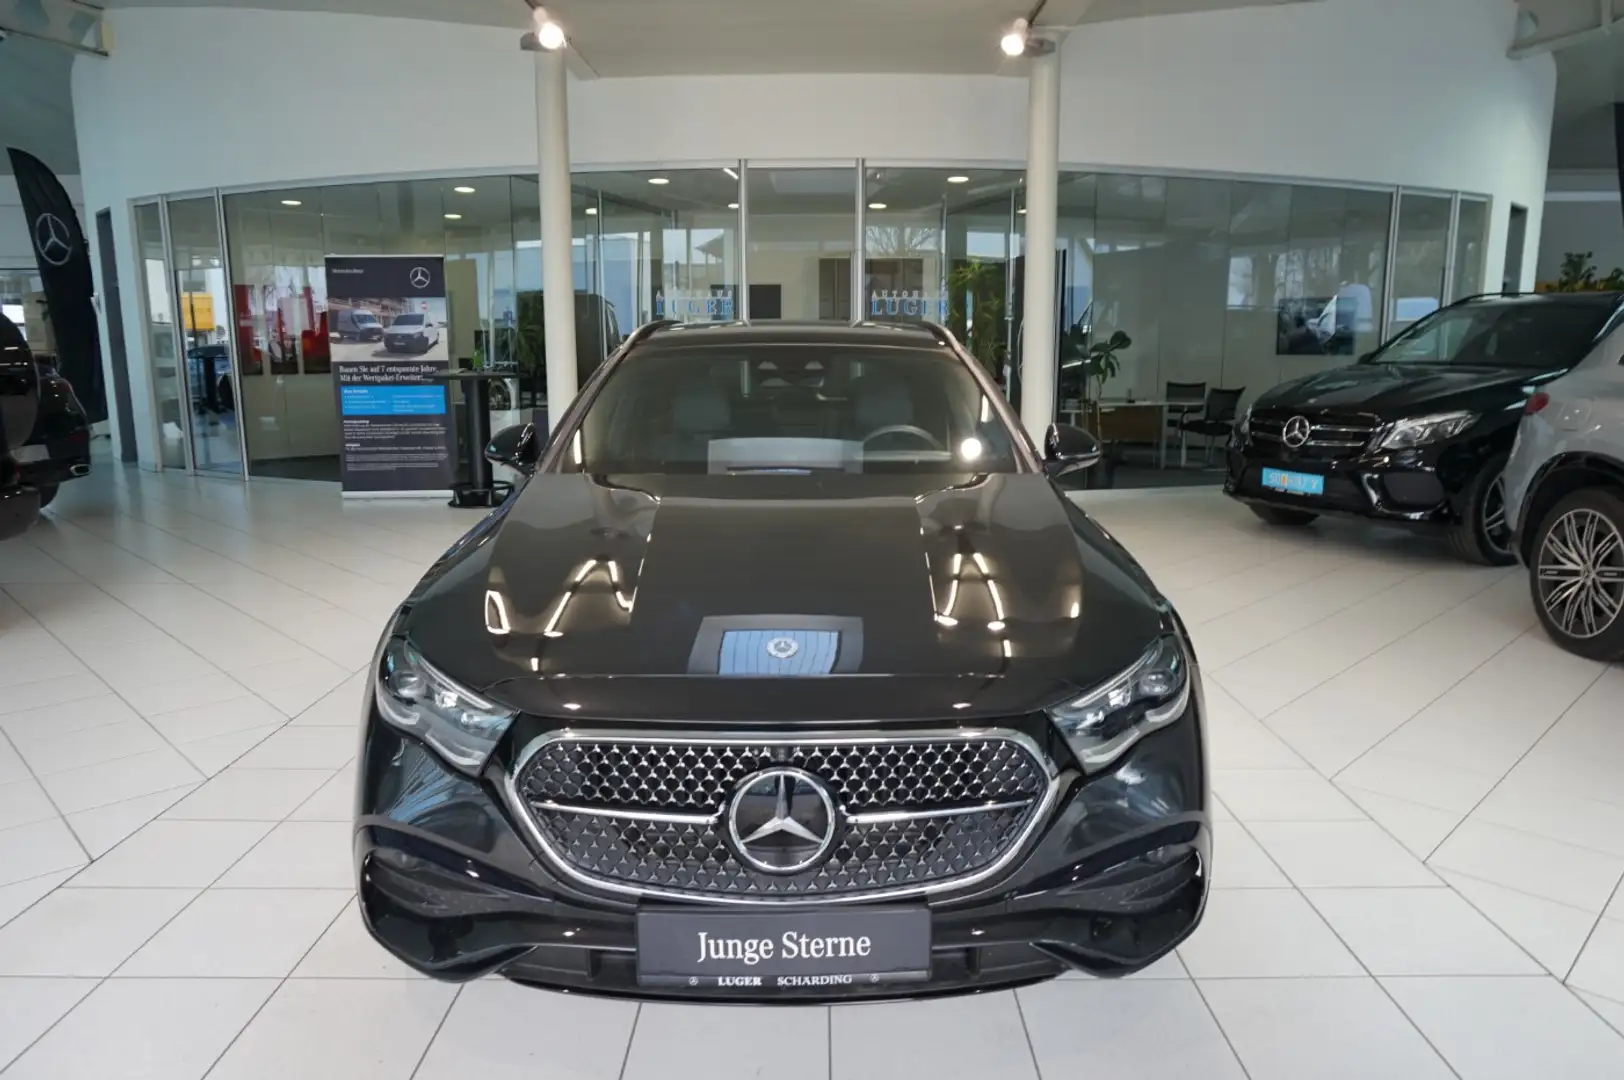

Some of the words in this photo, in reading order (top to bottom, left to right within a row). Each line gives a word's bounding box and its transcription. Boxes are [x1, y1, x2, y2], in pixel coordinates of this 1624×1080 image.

[359, 365, 368, 373] Sie
[370, 365, 380, 373] auf
[381, 365, 386, 373] 7
[386, 365, 419, 374] entspannte
[339, 374, 351, 382] Mit
[352, 374, 361, 382] der
[697, 932, 774, 965] Junge
[781, 931, 872, 959] Sterne
[718, 976, 762, 985] LUGER
